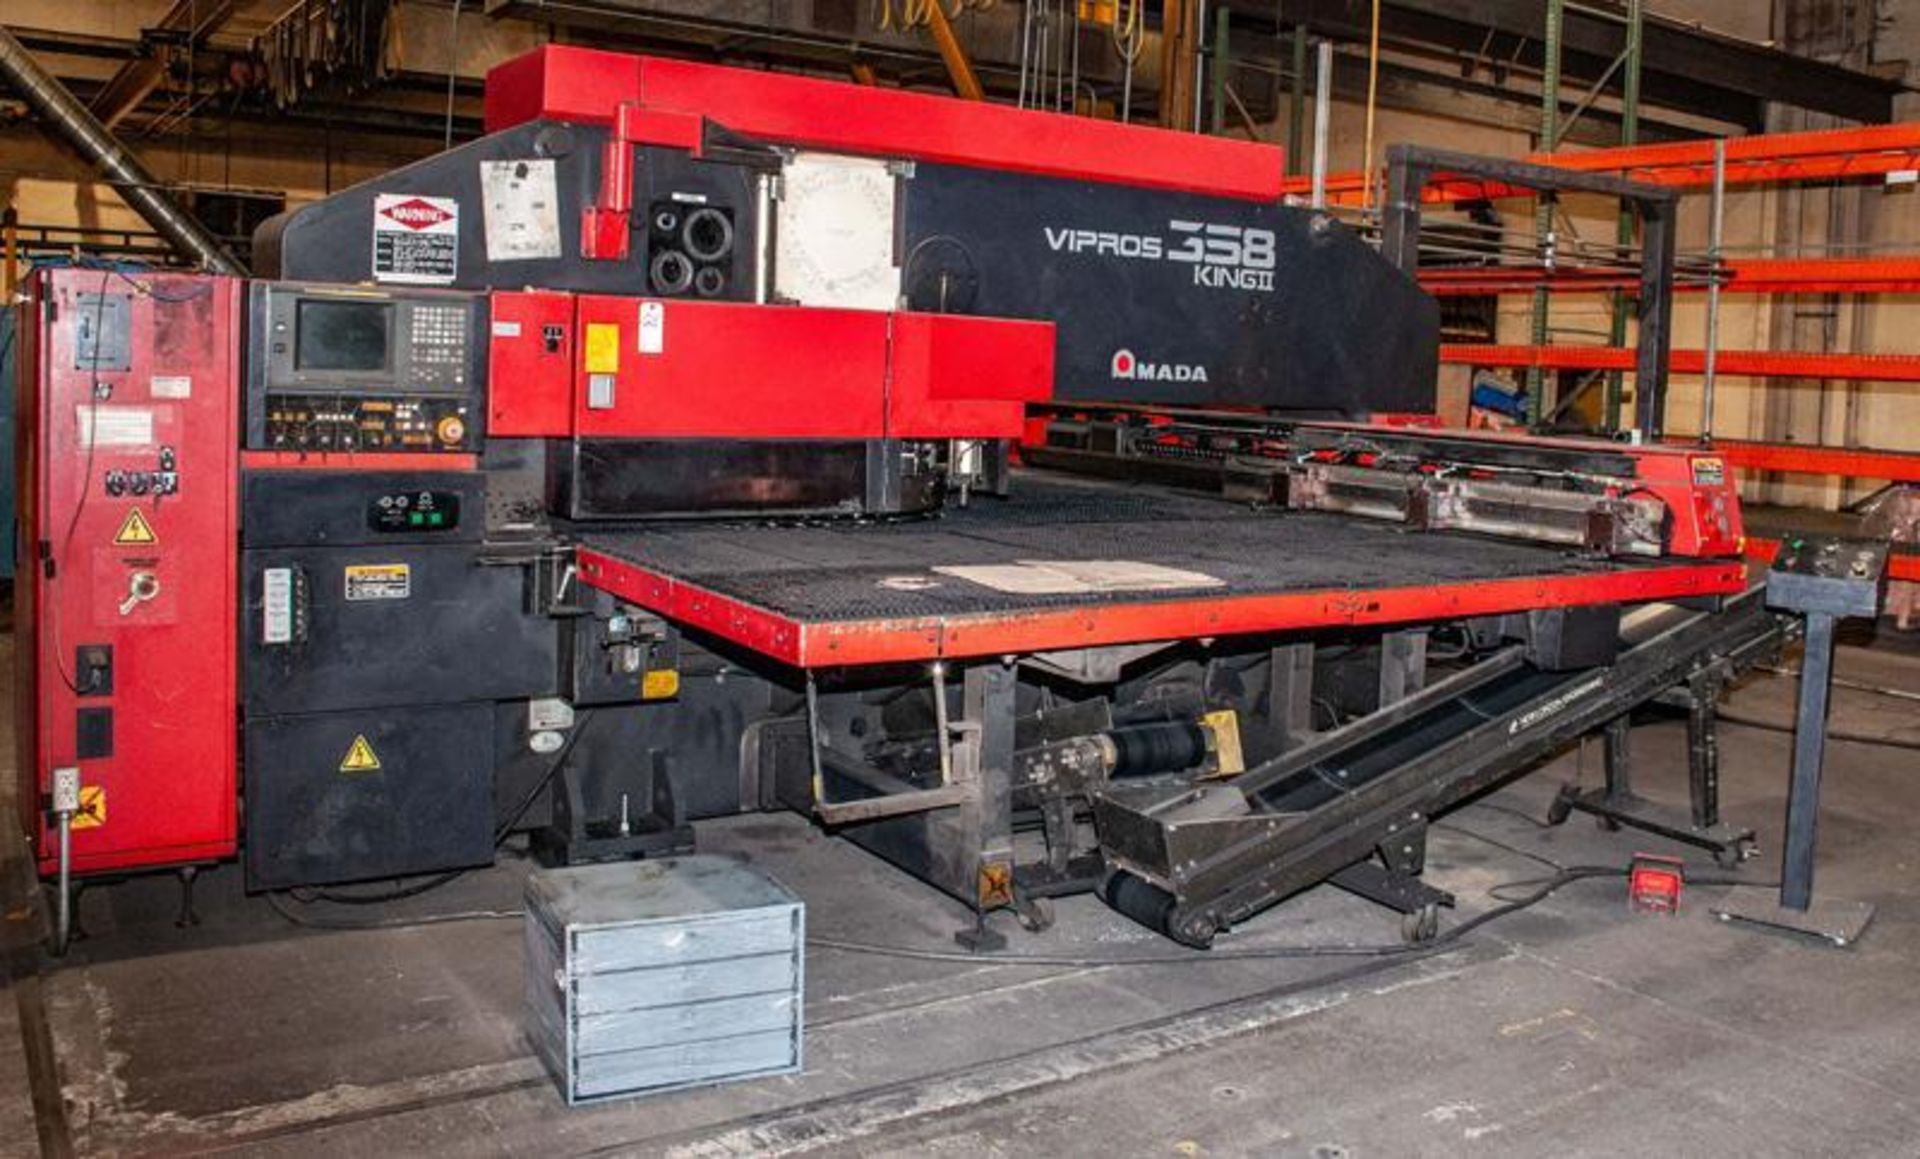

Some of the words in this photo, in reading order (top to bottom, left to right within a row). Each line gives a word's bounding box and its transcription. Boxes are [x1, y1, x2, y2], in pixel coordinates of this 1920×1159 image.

[390, 206, 443, 222] WARNING
[1043, 227, 1163, 259] VIPROS
[1167, 219, 1276, 269] 358
[1111, 348, 1209, 382] AMADA
